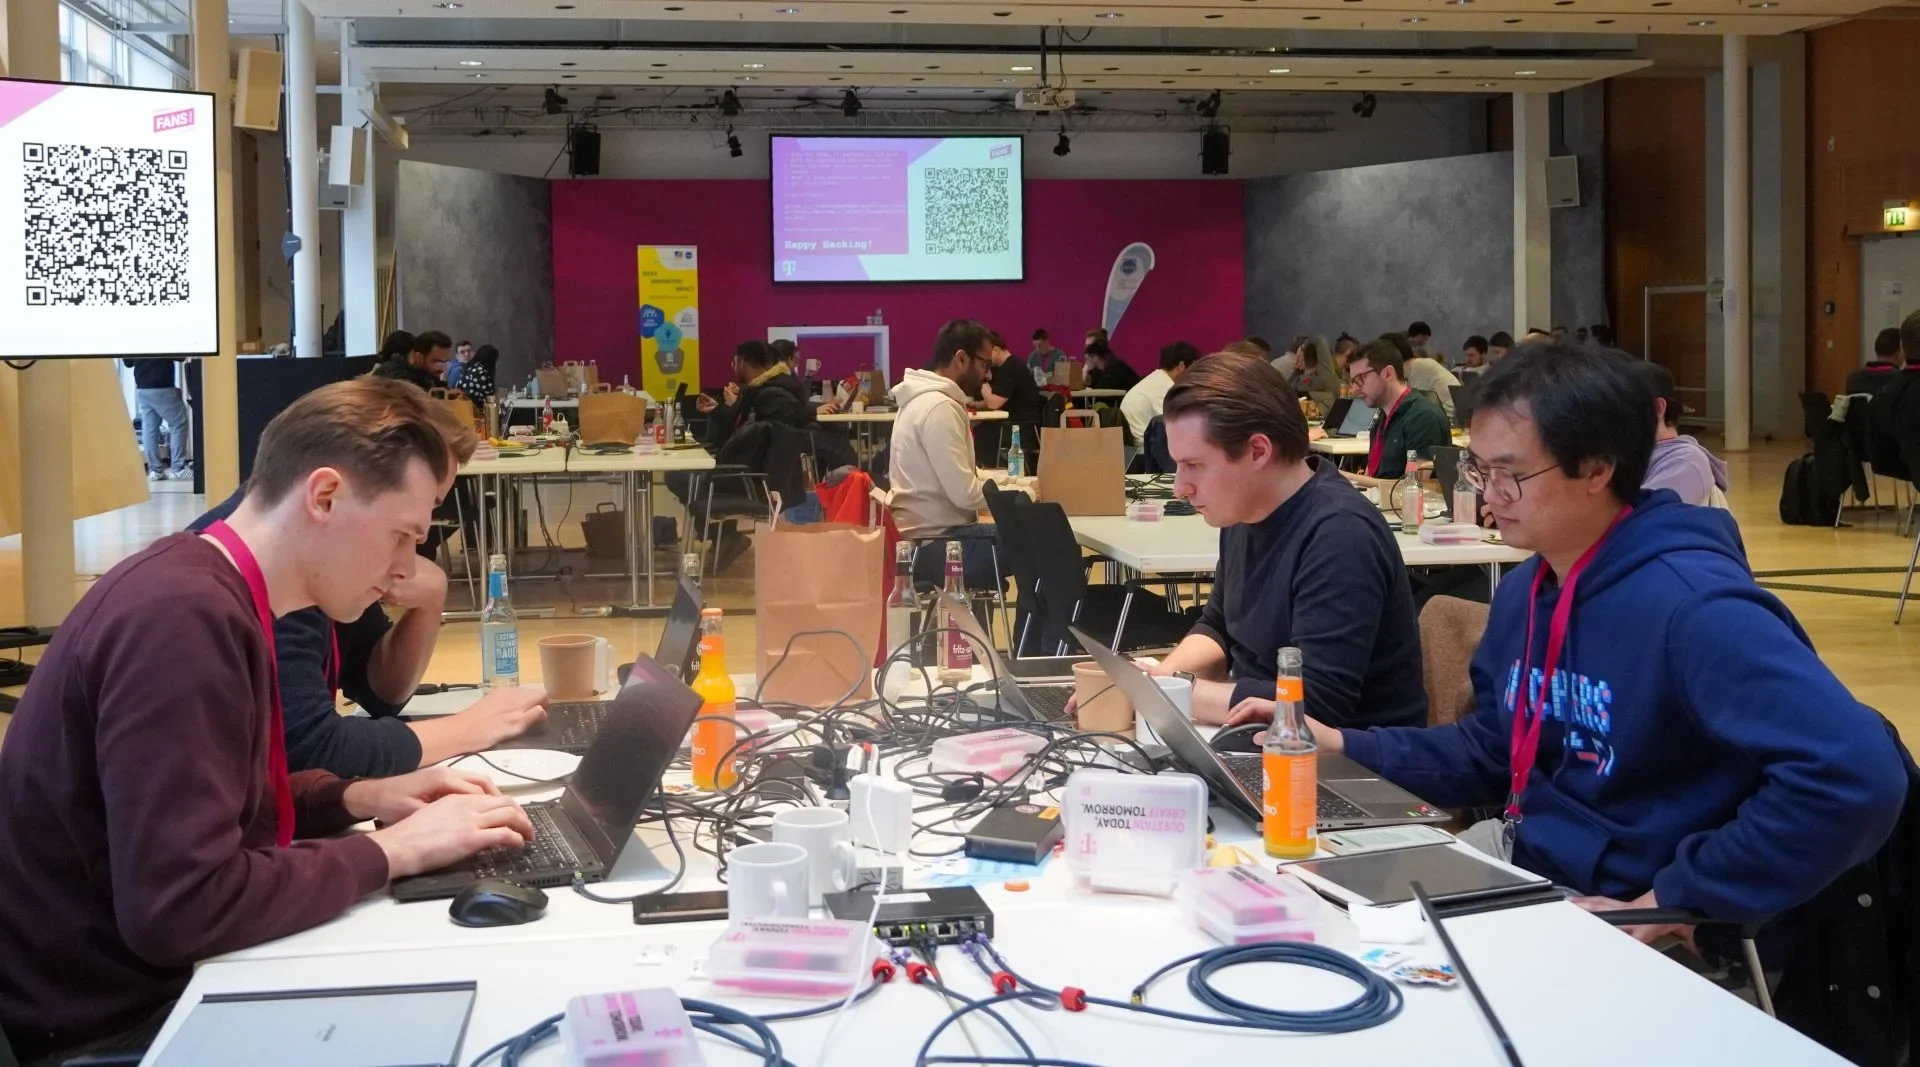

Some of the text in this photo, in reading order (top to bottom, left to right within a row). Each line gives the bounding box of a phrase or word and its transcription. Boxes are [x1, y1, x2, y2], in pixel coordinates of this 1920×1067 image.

[156, 112, 188, 130] FANS
[785, 240, 872, 251] Happy Hacking!
[1081, 803, 1146, 817] TOMORROW.
[1095, 816, 1131, 830] TODAY,
